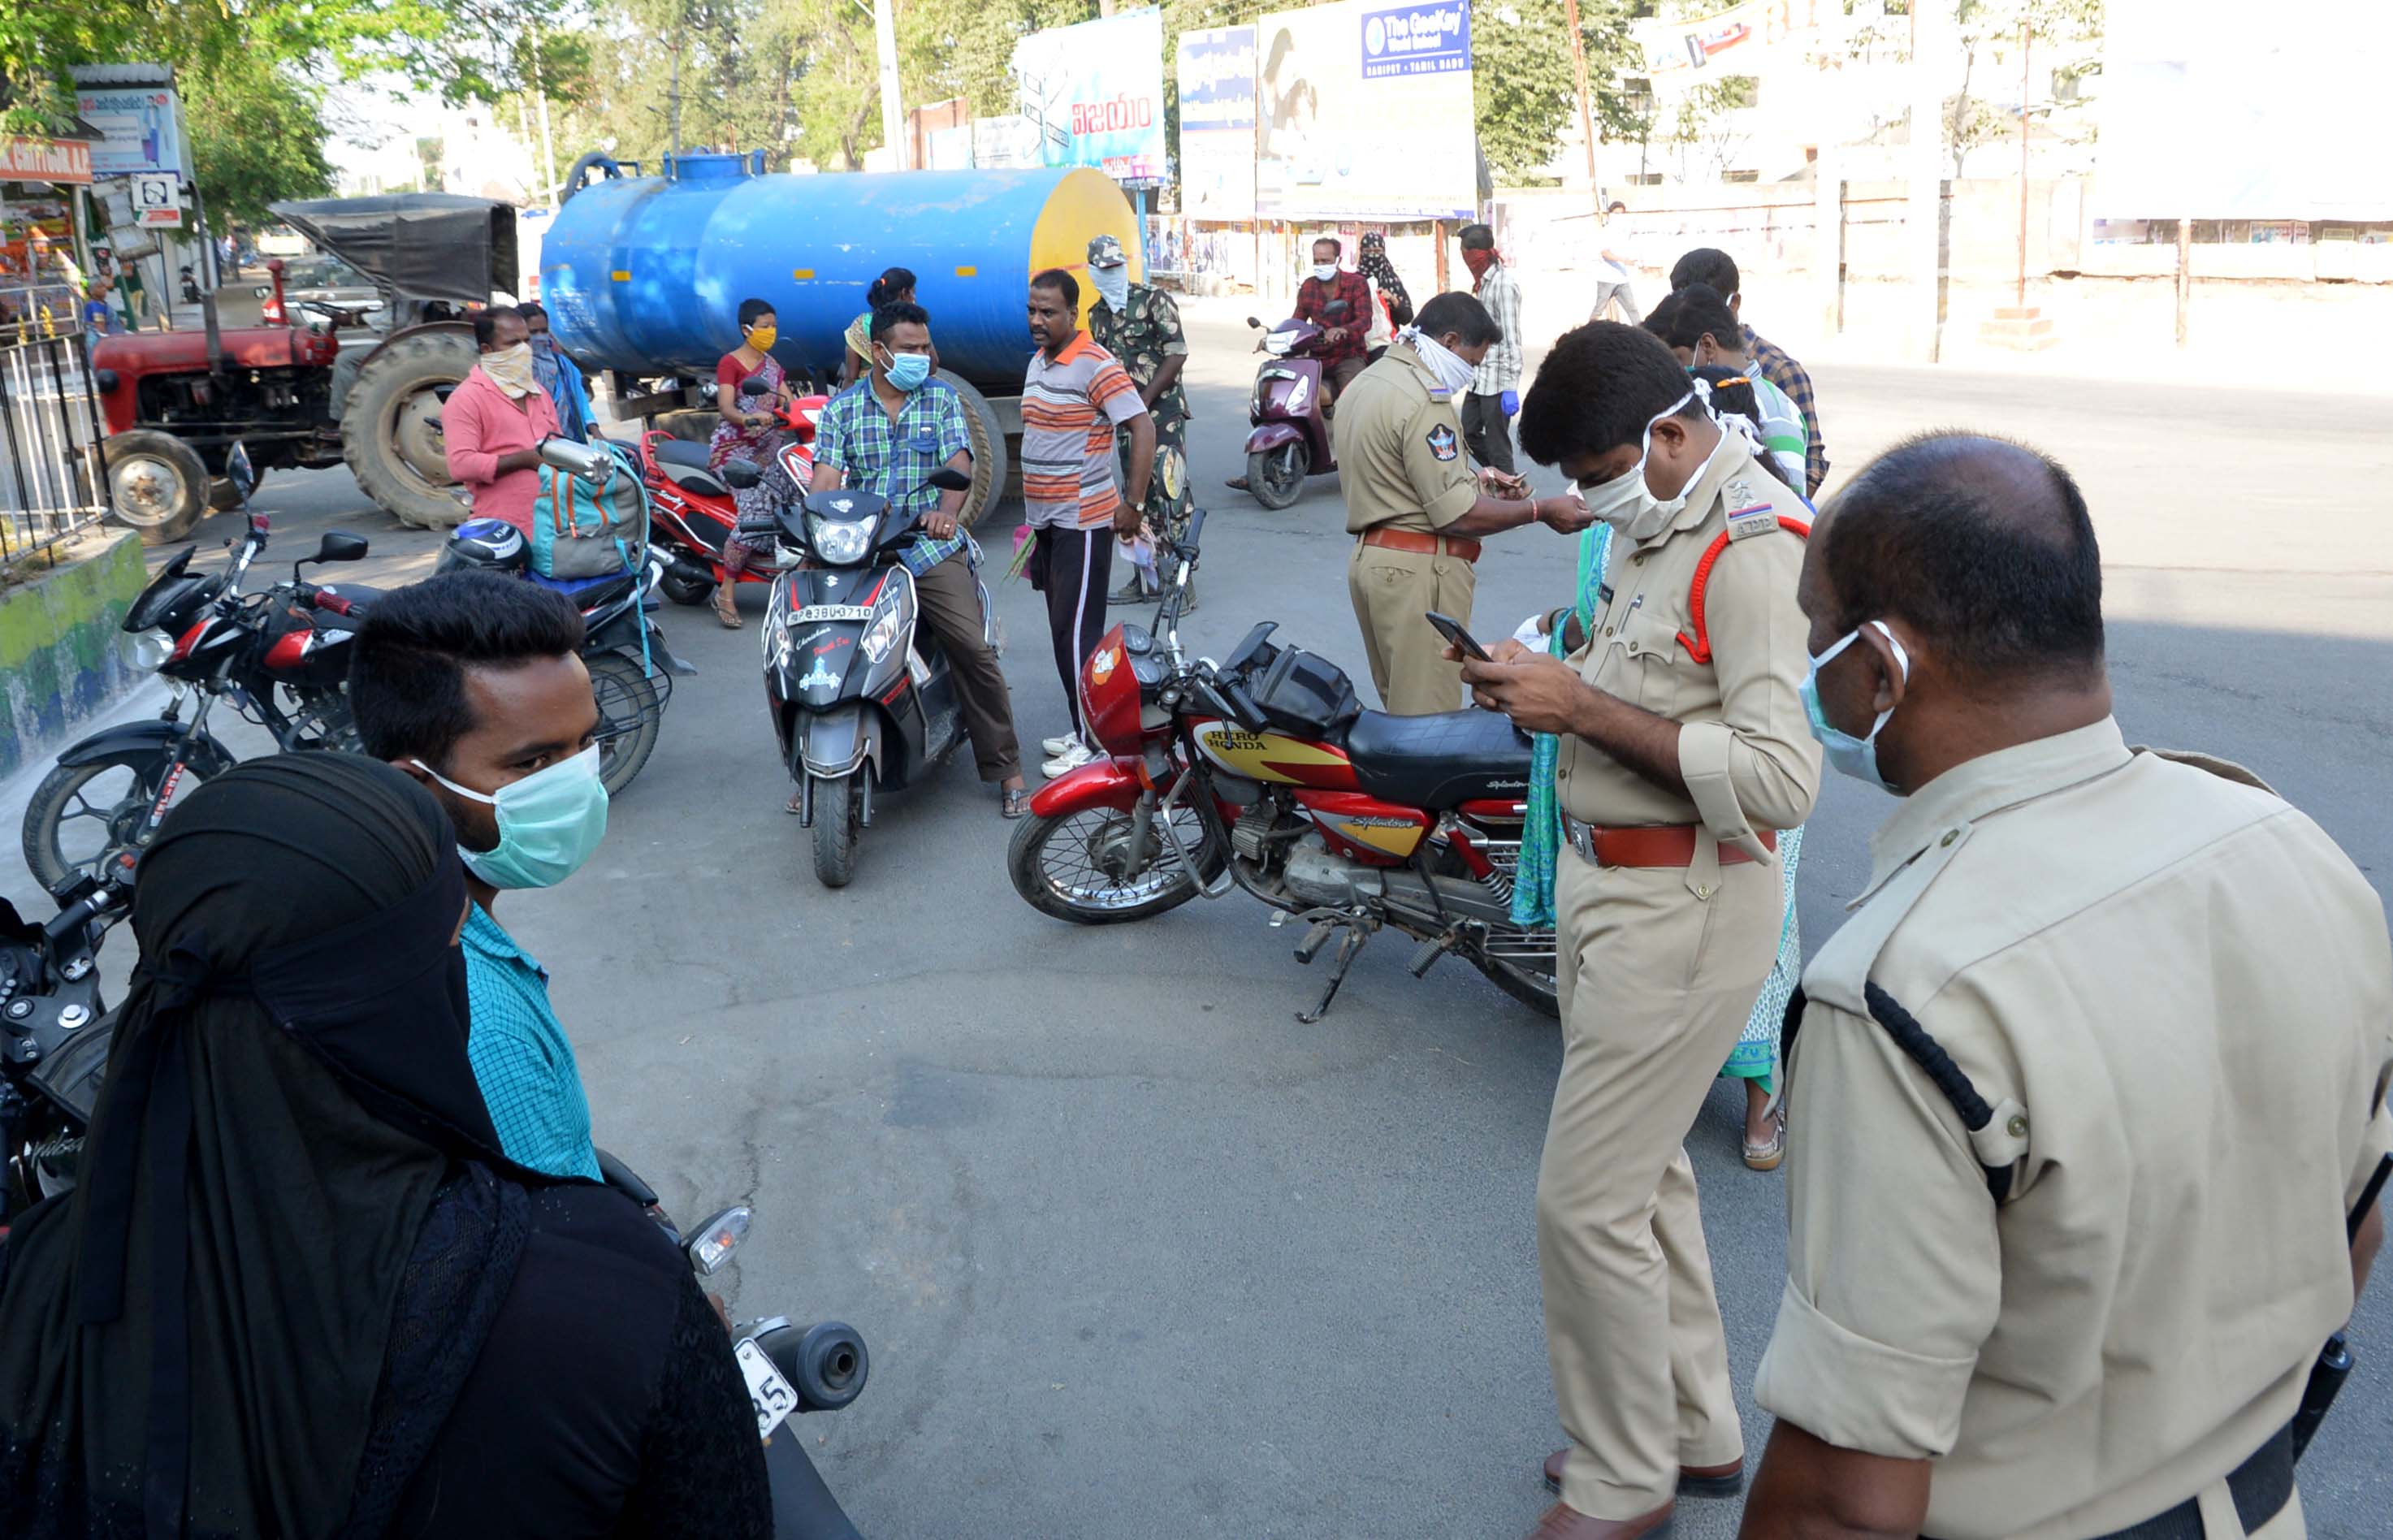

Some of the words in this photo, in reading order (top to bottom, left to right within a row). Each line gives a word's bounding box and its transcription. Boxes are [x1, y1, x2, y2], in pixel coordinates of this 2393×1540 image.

[1383, 15, 1409, 37] The
[1211, 730, 1261, 742] HERO
[1208, 739, 1268, 751] HONDA
